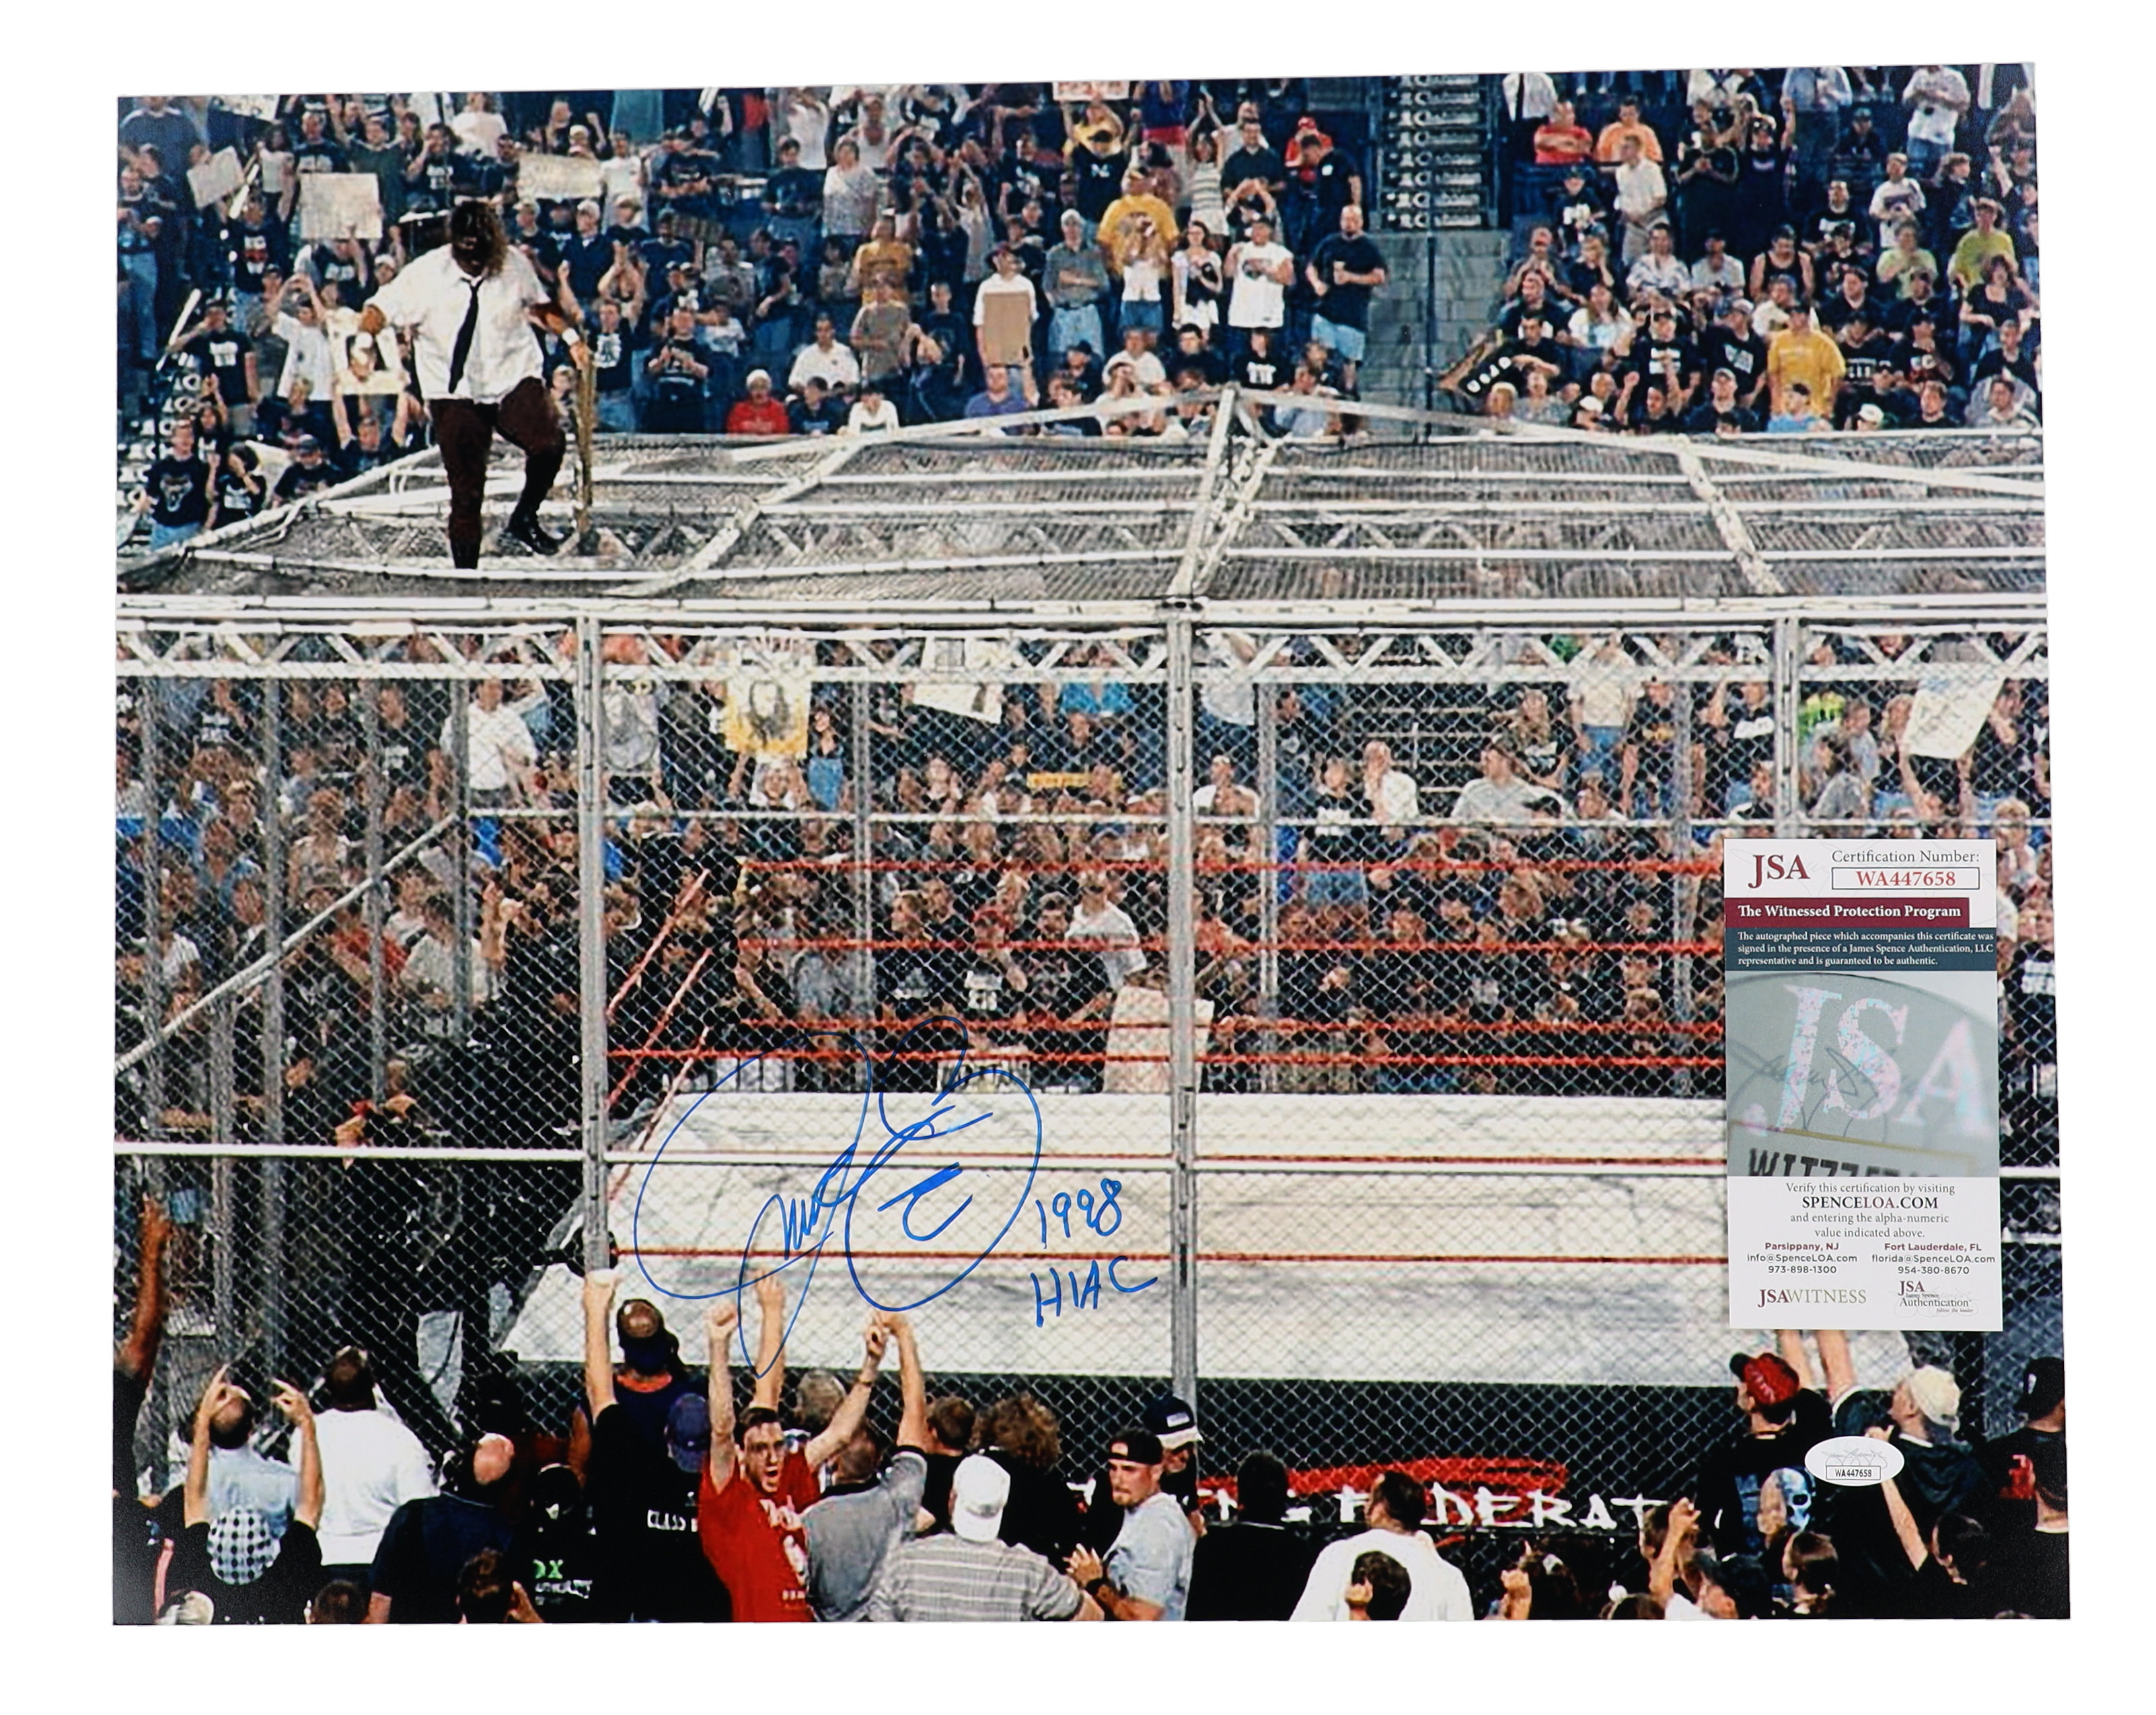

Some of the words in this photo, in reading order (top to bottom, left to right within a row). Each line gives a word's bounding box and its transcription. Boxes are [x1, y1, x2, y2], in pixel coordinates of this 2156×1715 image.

[1832, 850, 1915, 862] Certification
[1920, 850, 1978, 862] Number:
[1748, 855, 1810, 888] JSA
[1855, 870, 1956, 886] WA447658
[1738, 905, 1761, 916] The
[1764, 905, 1831, 916] Witnessed
[1834, 905, 1902, 916] Protection
[1904, 905, 1961, 919] Program
[1738, 931, 1754, 940] The
[1756, 931, 1808, 942] autographed
[1810, 932, 1831, 942] piece
[1833, 931, 1859, 940] which
[1861, 932, 1915, 942] accompanies
[1917, 931, 1933, 940] this
[1935, 931, 1976, 940] certificate
[1738, 944, 1765, 954] signed
[1768, 944, 1776, 952] in
[1779, 944, 1791, 952] the
[1793, 946, 1830, 954] presence
[1832, 944, 1841, 952] of
[1850, 944, 1874, 954] James
[1876, 944, 1906, 954] Spence
[1908, 944, 1973, 953] Authentication,
[1975, 944, 1993, 952] LLC
[1738, 957, 1797, 966] representative
[1798, 956, 1815, 964] and
[1825, 956, 1871, 967] guaranteed
[1884, 956, 1894, 964] be
[1896, 956, 1937, 964] authentic.
[1786, 1182, 1816, 1194] Verify
[1819, 1182, 1837, 1192] this
[1841, 1182, 1900, 1192] certification
[1903, 1183, 1915, 1195] by
[1918, 1184, 1955, 1195] visiting
[1803, 1196, 1937, 1209] SPENCELOA.COM
[1035, 1178, 1122, 1249] 1998
[1791, 1213, 1808, 1221] and
[1812, 1213, 1853, 1225] entering
[1857, 1213, 1872, 1222] the
[1875, 1213, 1949, 1225] alpha-numeric
[1815, 1227, 1841, 1237] value
[1845, 1227, 1890, 1237] indicated
[1894, 1227, 1925, 1237] above.
[1765, 1242, 1823, 1252] Parsippany,
[1908, 1244, 1966, 1252] Lauderdale,
[1748, 1254, 1857, 1263] info@SpenceLOA.com
[1872, 1254, 1995, 1264] florida@SpenceLOA.com
[1898, 1280, 1925, 1296] JSA
